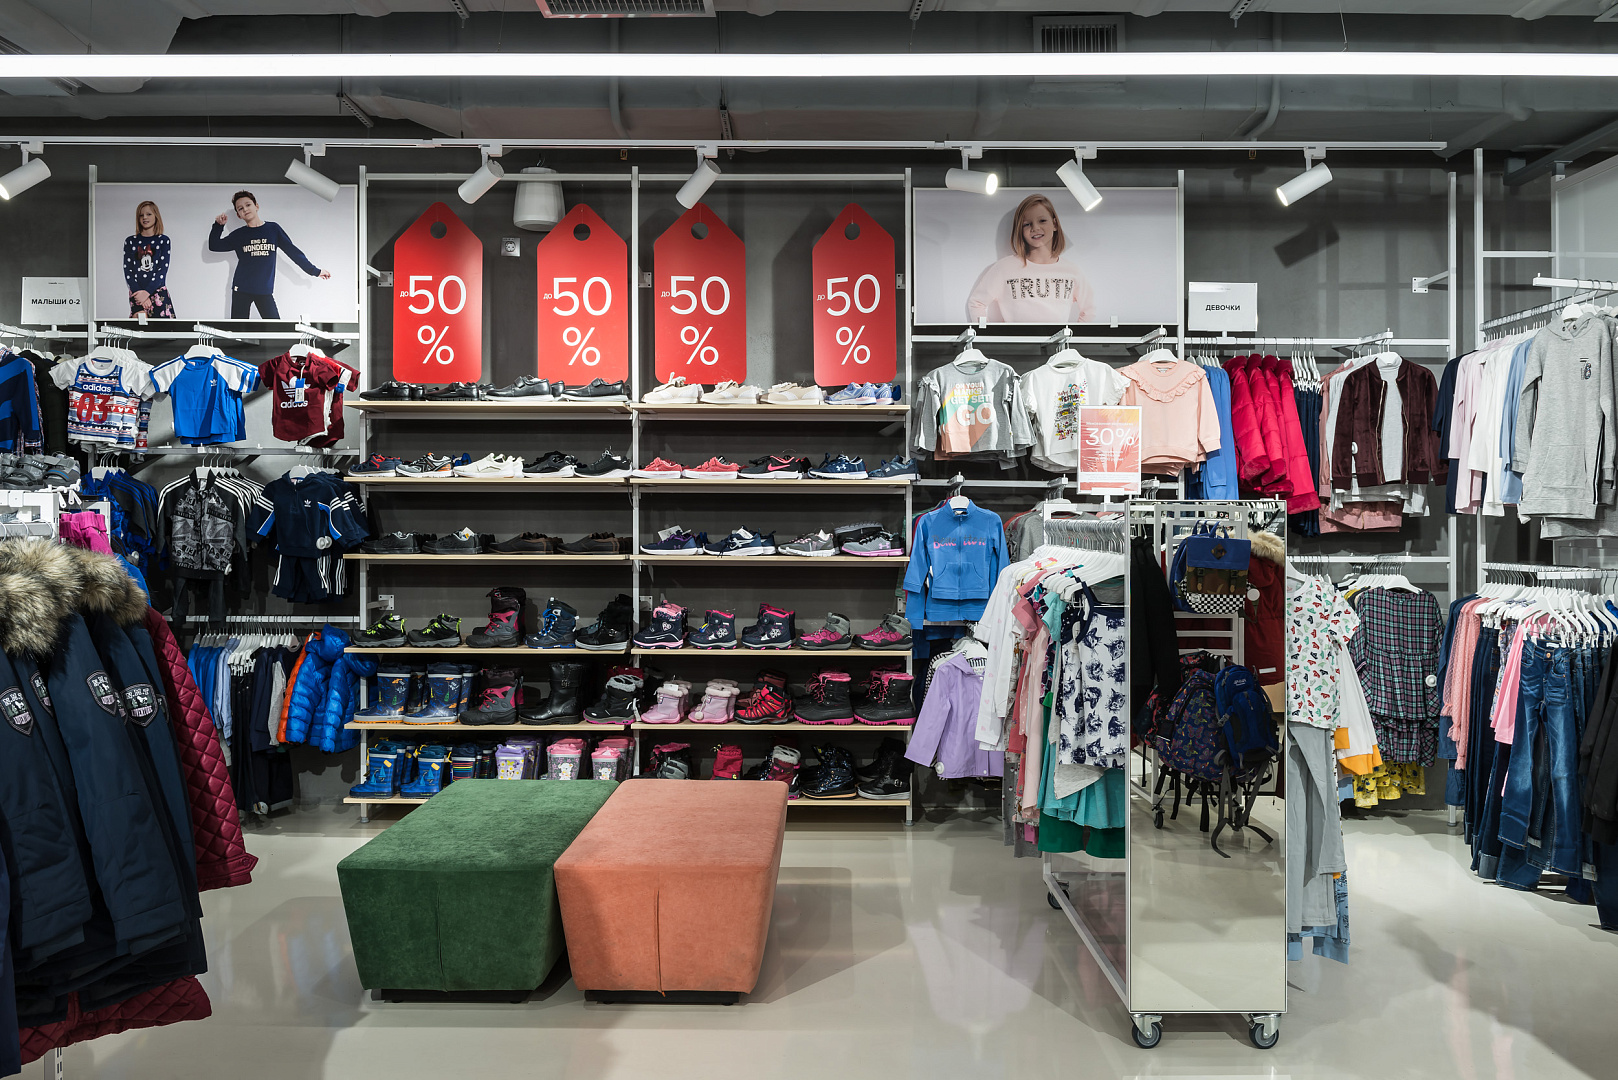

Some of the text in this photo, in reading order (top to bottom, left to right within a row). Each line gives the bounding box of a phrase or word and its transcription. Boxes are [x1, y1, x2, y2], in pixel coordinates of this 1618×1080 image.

[408, 275, 467, 315] 50
[552, 276, 612, 316] 50
[670, 275, 731, 315] 50
[826, 273, 881, 317] 50
[1006, 278, 1074, 300] TRUTH
[1205, 304, 1241, 312] ДЕВОЧКИ
[417, 325, 455, 365] %
[562, 326, 601, 366] %
[680, 325, 719, 366] %
[835, 325, 871, 366] %
[77, 392, 111, 424] 03
[82, 383, 112, 393] adidas
[950, 394, 990, 405] GET SET
[956, 402, 996, 427] GO
[1085, 427, 1135, 446] 30%
